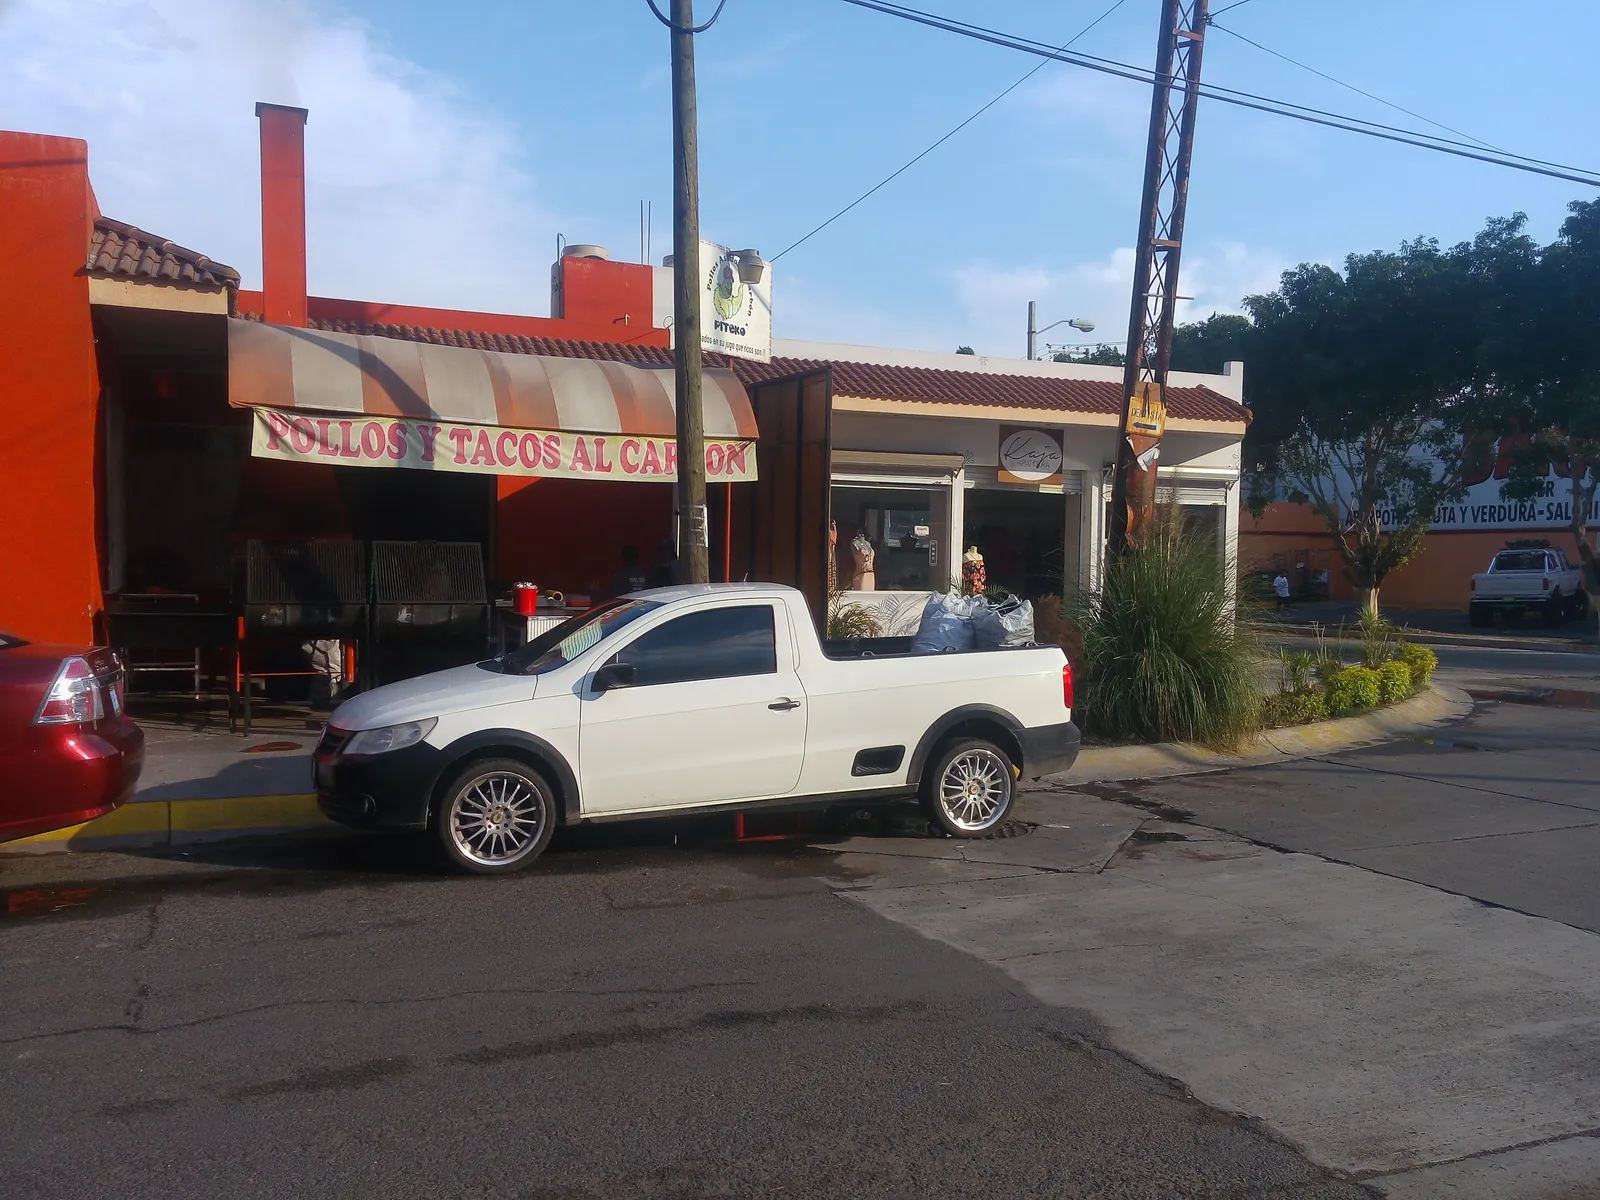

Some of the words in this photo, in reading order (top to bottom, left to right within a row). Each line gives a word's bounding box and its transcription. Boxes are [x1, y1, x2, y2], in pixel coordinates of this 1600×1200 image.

[706, 262, 719, 292] Pollos
[701, 334, 712, 345] ados
[713, 338, 719, 346] en
[719, 339, 725, 347] su
[725, 339, 735, 352] jugo
[735, 343, 743, 353] que
[754, 348, 762, 356] son
[266, 412, 408, 460] POLLOS
[416, 424, 441, 462] Y
[449, 427, 561, 470] TACOS
[569, 436, 612, 473] AL
[620, 439, 747, 475] CARON
[1003, 436, 1061, 469] Kaja
[1460, 506, 1468, 524] Y
